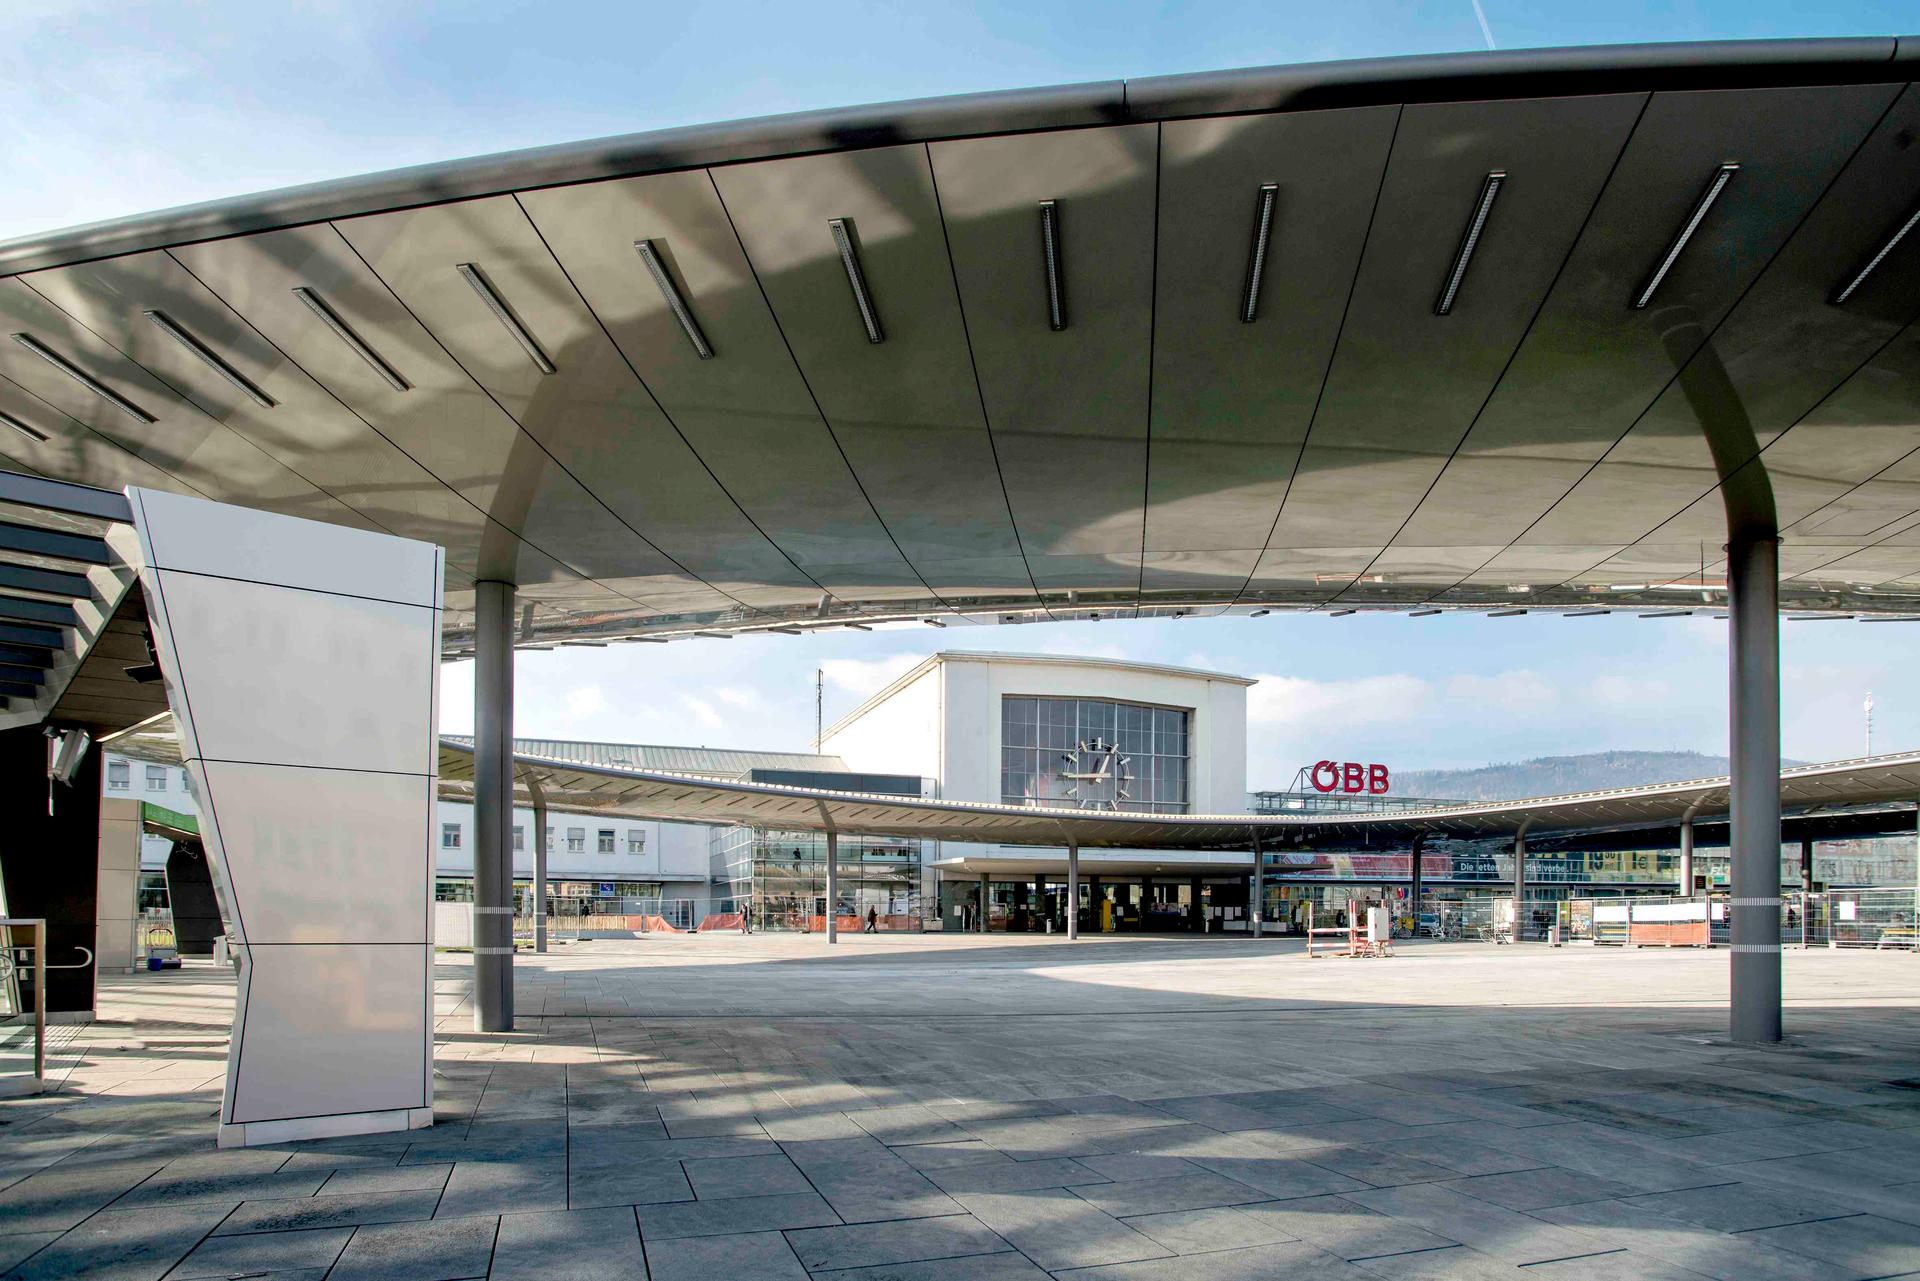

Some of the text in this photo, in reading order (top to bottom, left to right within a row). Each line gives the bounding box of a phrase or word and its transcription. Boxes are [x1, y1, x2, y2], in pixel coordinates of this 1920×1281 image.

[1312, 760, 1389, 794] ÖBB
[1460, 862, 1474, 871] Die
[1477, 863, 1500, 872] etten
[1525, 863, 1542, 872] sind
[1543, 863, 1569, 872] vorbe.
